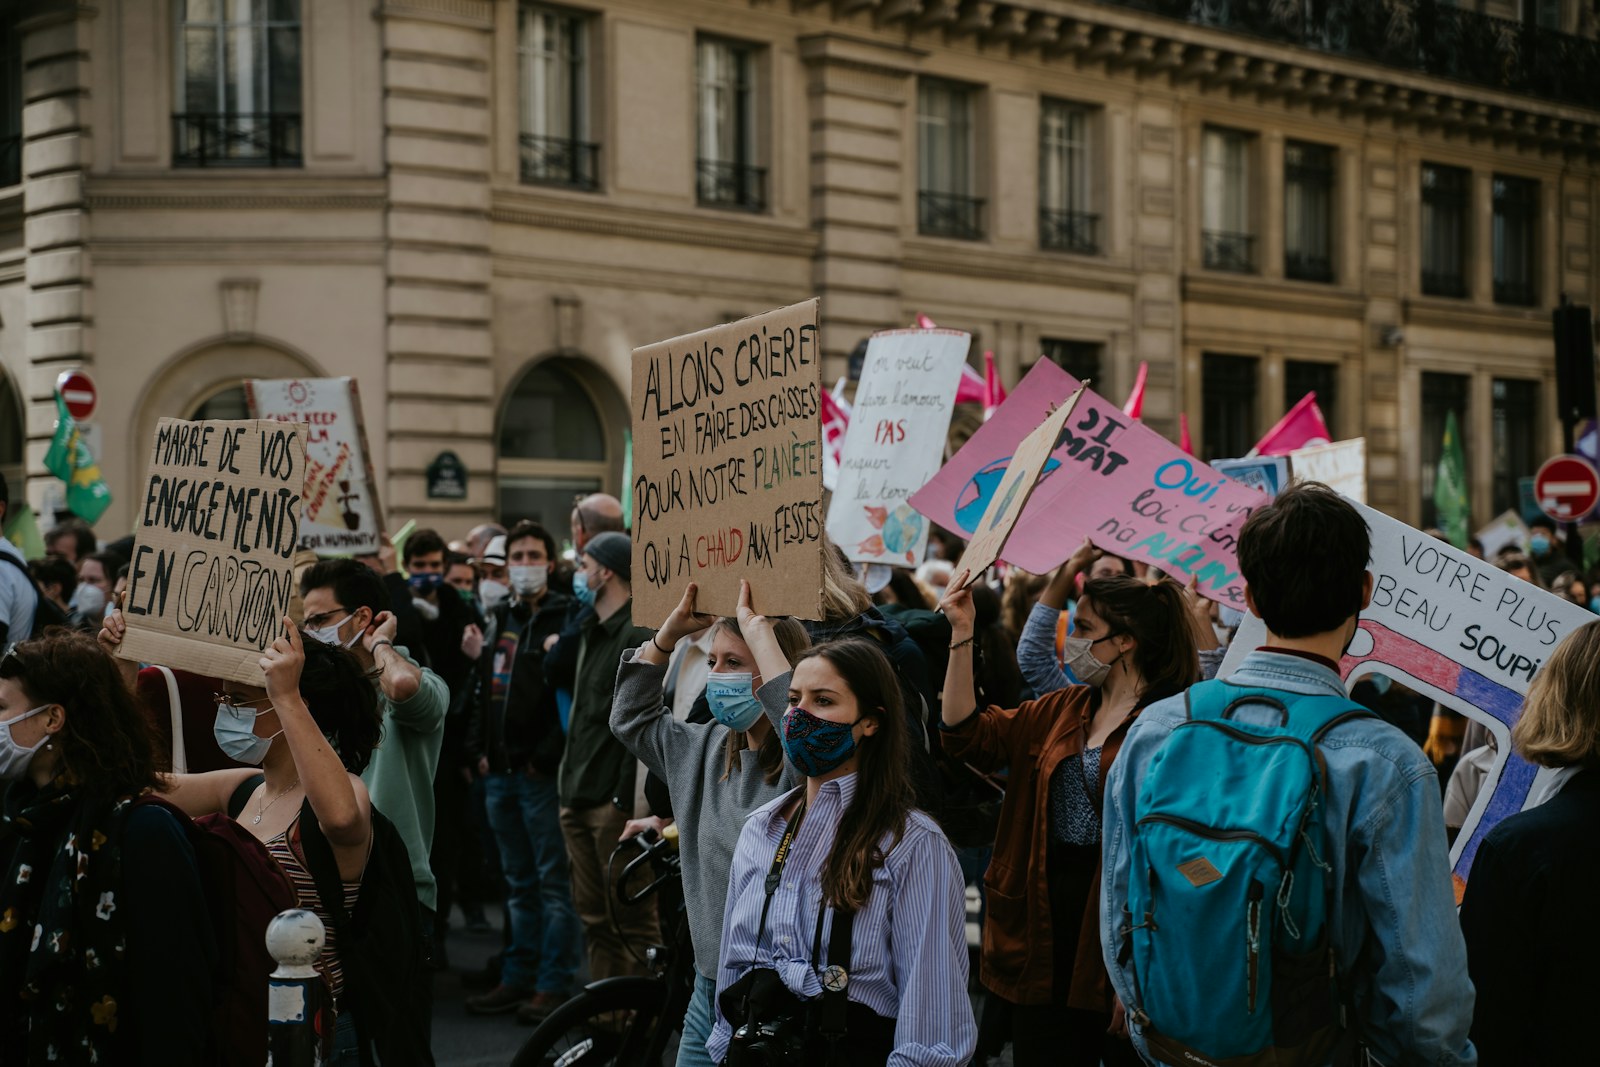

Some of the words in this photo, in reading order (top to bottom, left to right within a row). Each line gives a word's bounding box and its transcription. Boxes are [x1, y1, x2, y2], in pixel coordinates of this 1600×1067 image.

[642, 341, 724, 421] ALLONS
[799, 324, 817, 365] ET
[894, 349, 935, 372] veut
[155, 424, 215, 467] MARRE
[218, 426, 247, 475] DE
[260, 430, 297, 481] VOS
[660, 418, 686, 460] EN
[739, 399, 766, 438] DES
[875, 418, 906, 445] PAS
[143, 474, 300, 559] ENGAGEMENTS
[635, 468, 685, 543] POUR
[689, 457, 748, 509] NOTRE
[754, 431, 818, 490] PLANÈTE
[301, 534, 323, 549] FOR
[324, 532, 376, 547] HUMANITY
[678, 533, 691, 577] A
[696, 526, 744, 569] CHAUD
[747, 521, 773, 570] AUX
[774, 500, 821, 553] FESSES
[127, 545, 175, 617] EN
[176, 550, 292, 651] CARTON
[1372, 574, 1452, 632] BEAU
[1401, 534, 1492, 602] VOTRE
[1495, 587, 1561, 646] PLUS
[775, 832, 791, 863] Nikon
